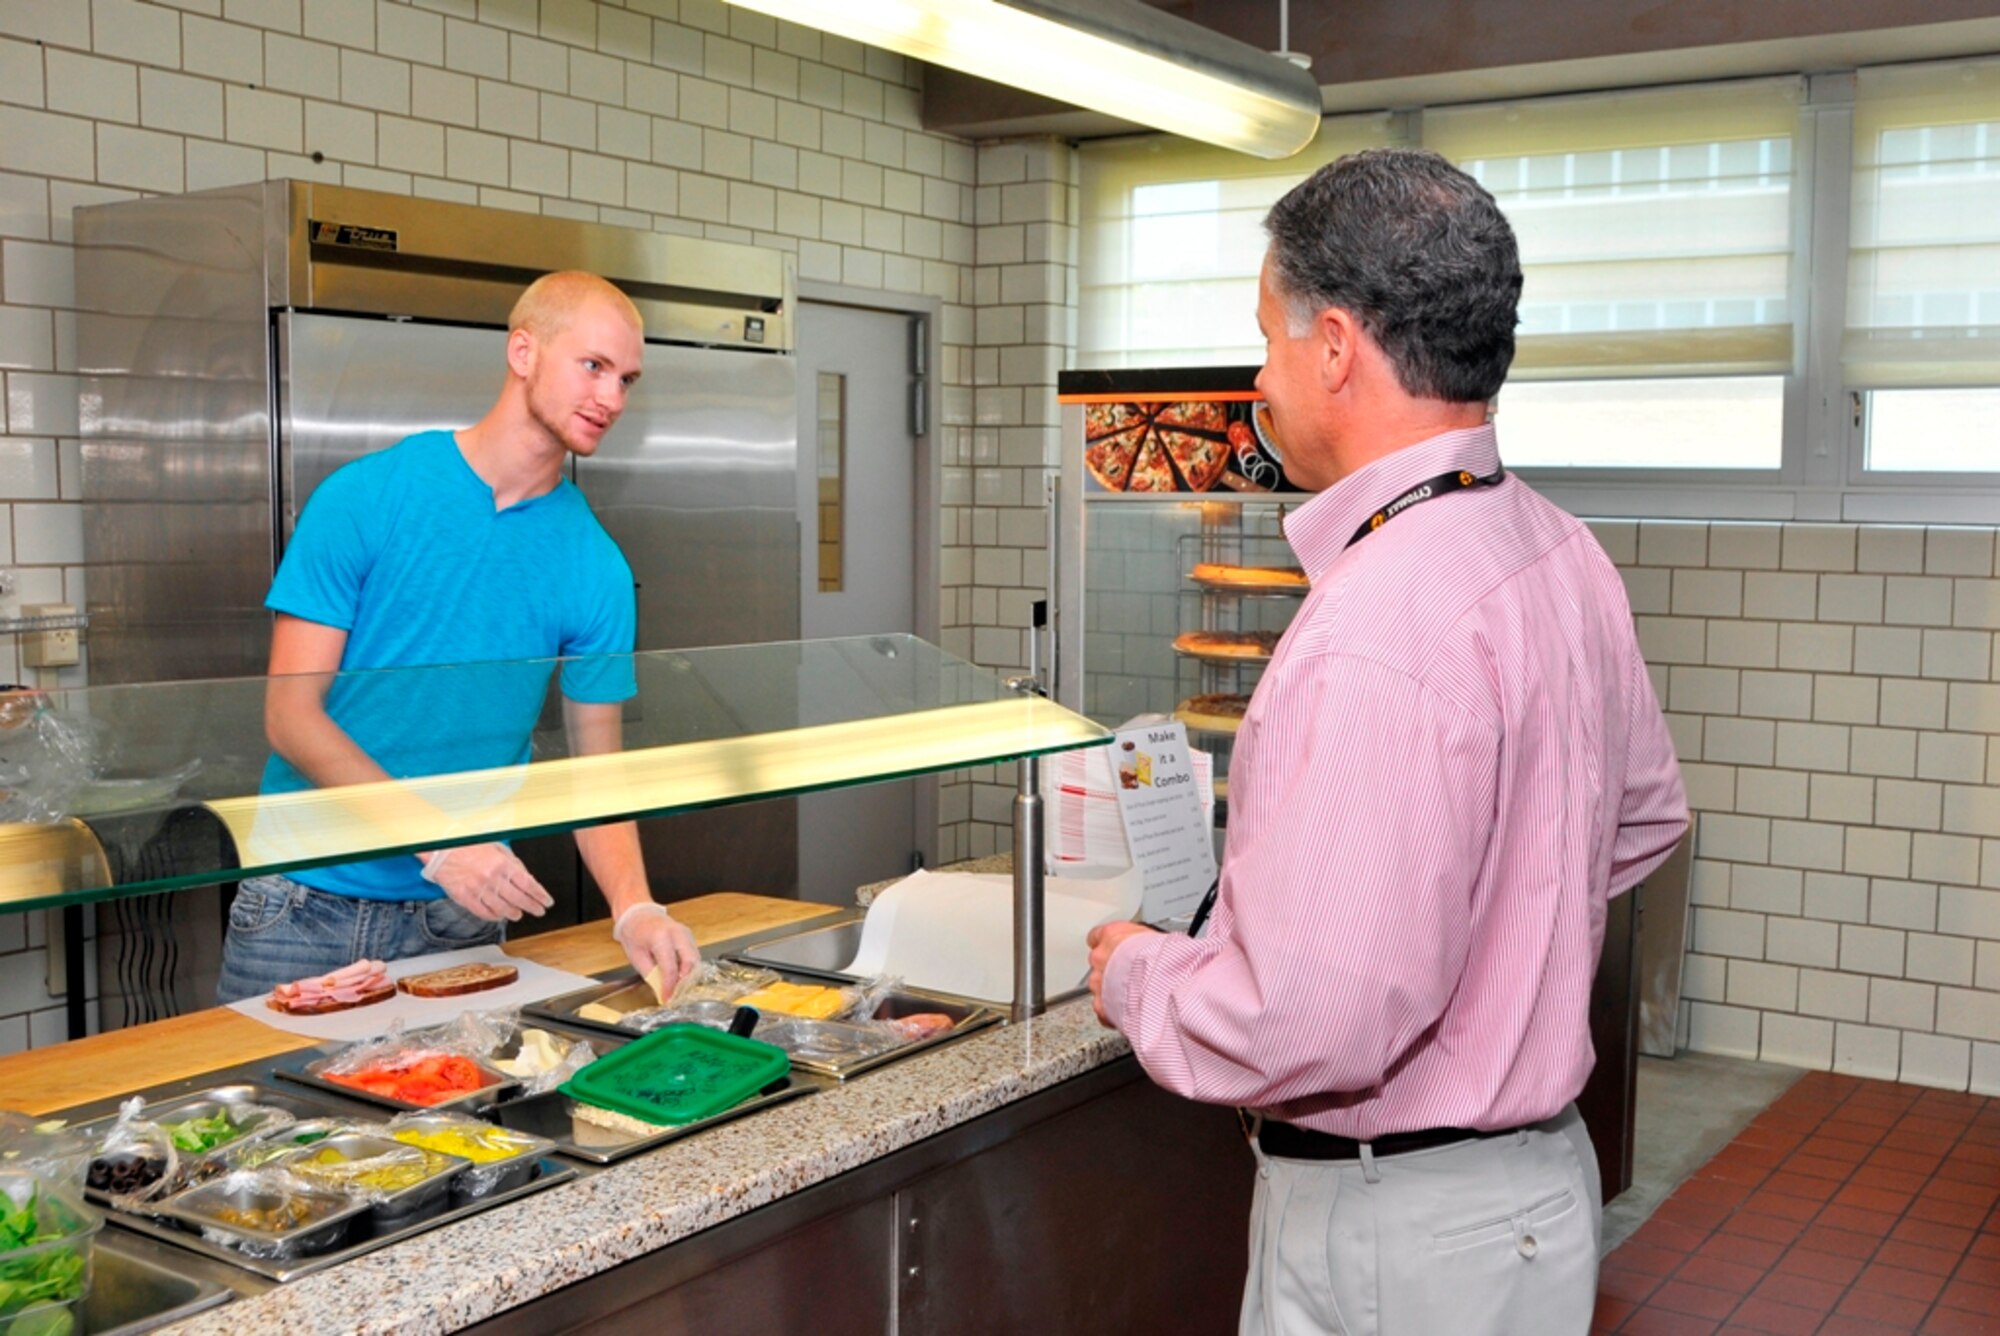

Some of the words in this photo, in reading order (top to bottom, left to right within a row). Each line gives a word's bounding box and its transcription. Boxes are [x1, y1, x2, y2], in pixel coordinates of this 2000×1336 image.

[1147, 730, 1176, 744] Make
[1159, 753, 1168, 765] it
[1169, 754, 1176, 763] a
[1154, 772, 1191, 788] Combo
